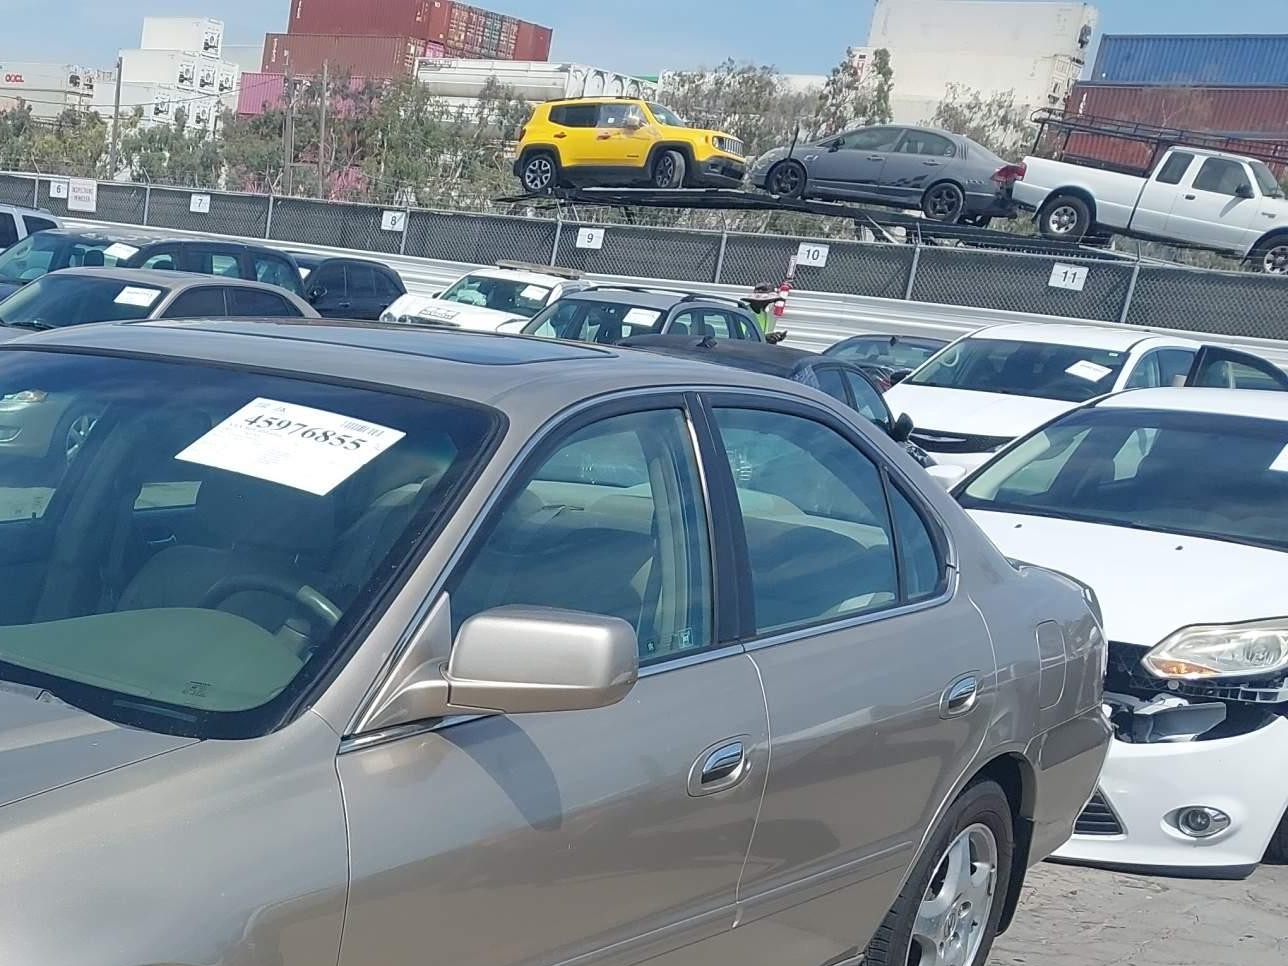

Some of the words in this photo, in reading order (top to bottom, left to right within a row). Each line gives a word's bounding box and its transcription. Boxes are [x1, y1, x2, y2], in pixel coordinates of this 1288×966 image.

[5, 74, 24, 83] OOCL
[56, 185, 62, 194] 6
[197, 199, 203, 208] 7
[390, 215, 398, 226] 8
[587, 233, 594, 243] 9
[805, 249, 820, 261] 10
[1062, 270, 1077, 284] 11
[244, 414, 368, 451] 45976855
